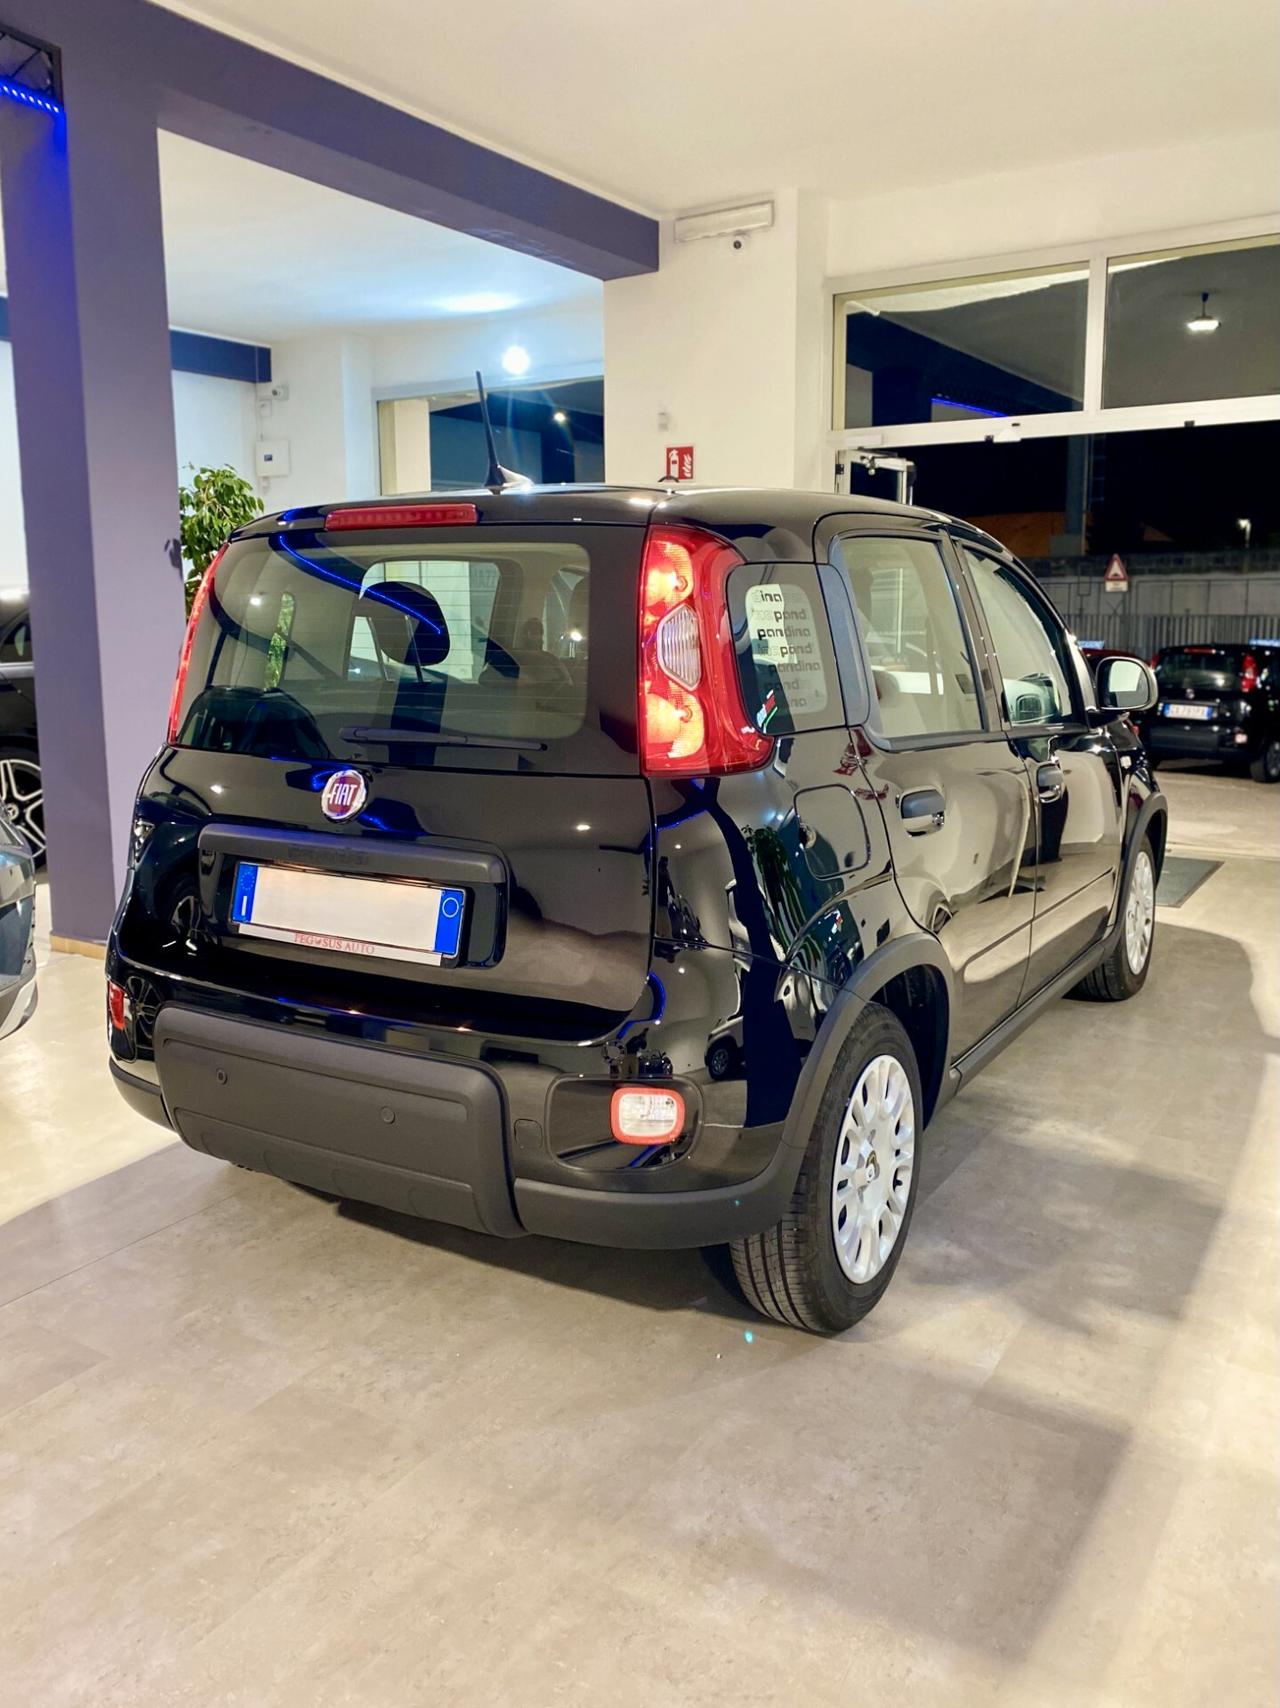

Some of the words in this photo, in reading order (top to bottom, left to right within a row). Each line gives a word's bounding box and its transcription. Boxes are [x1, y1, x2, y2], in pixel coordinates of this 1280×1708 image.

[774, 608, 807, 623] pand
[757, 626, 811, 641] pandina
[780, 643, 813, 658] pand
[329, 783, 358, 806] FIAT
[344, 941, 375, 955] AUTO
